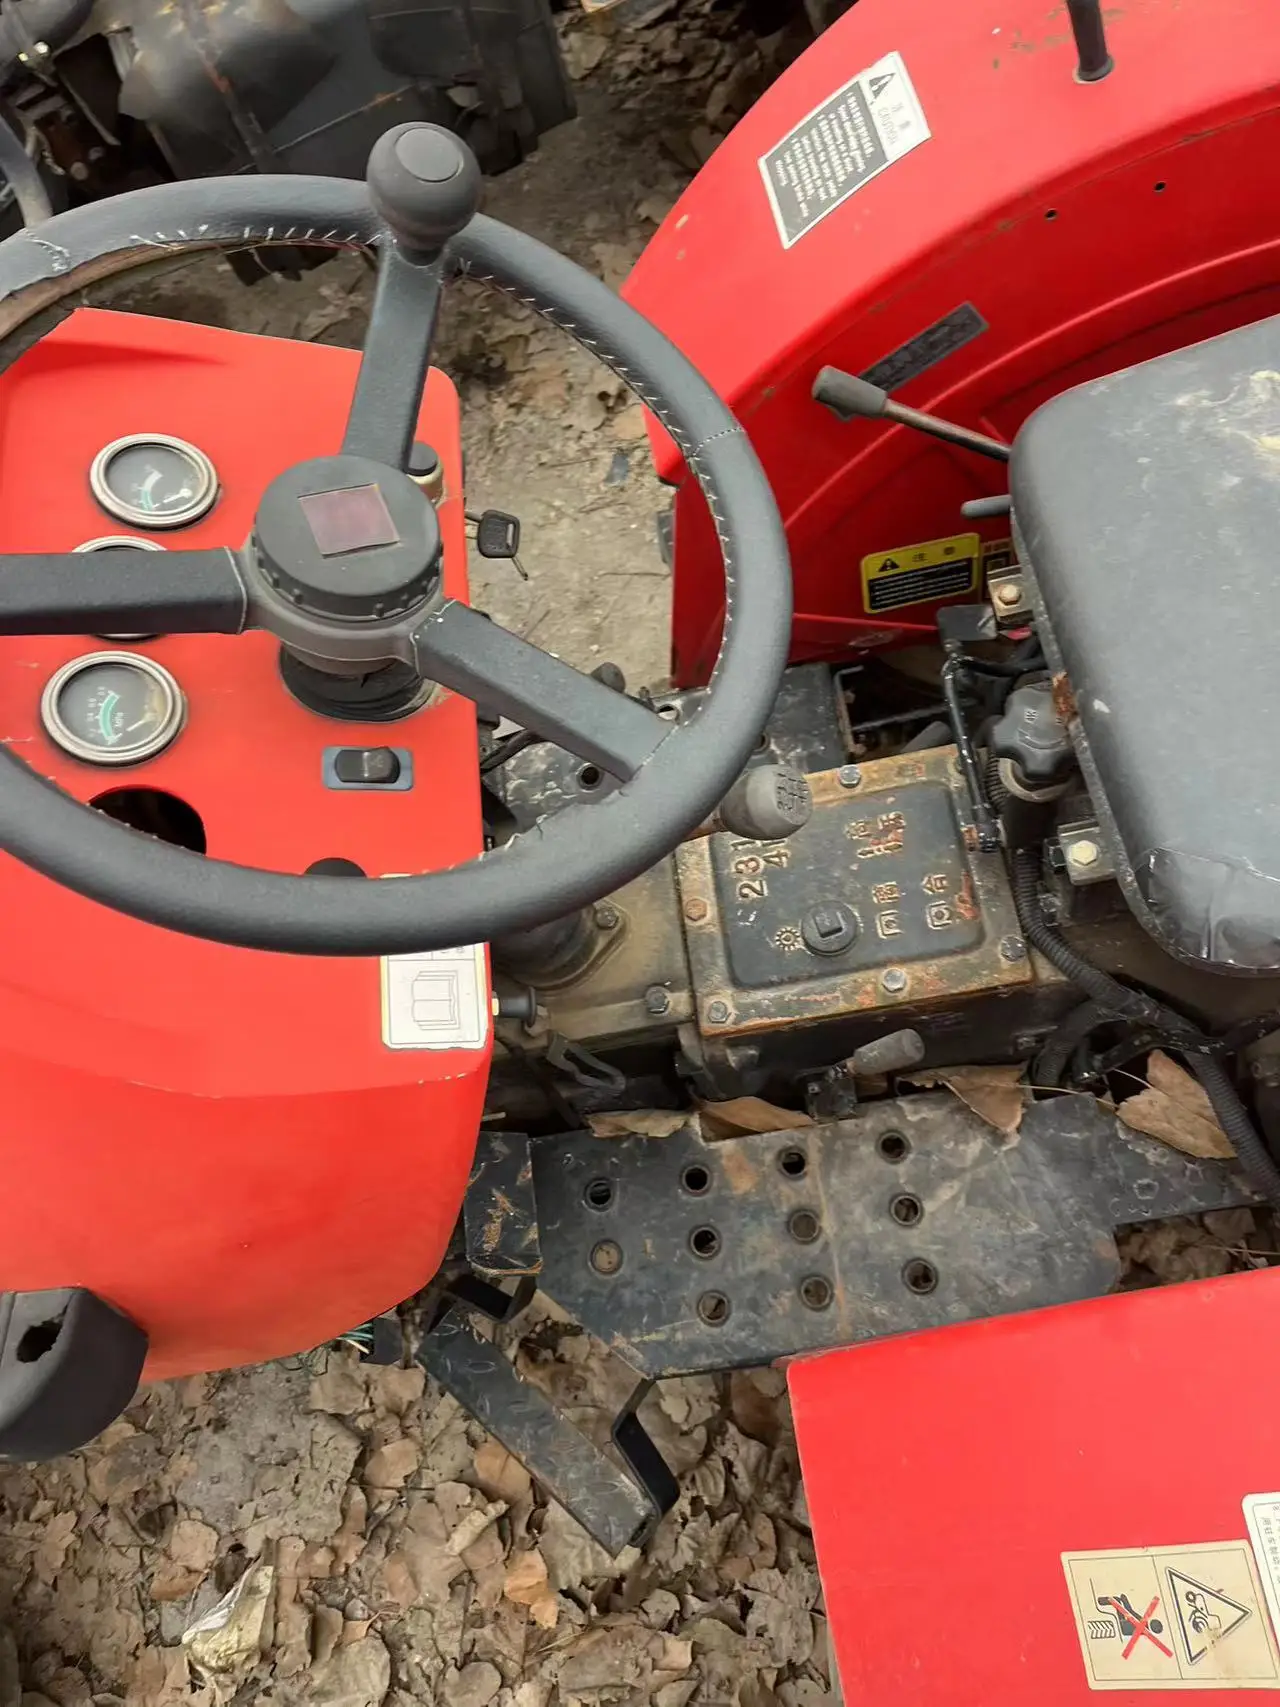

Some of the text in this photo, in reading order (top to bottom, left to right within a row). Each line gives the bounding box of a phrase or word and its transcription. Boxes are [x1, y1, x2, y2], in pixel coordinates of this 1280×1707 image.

[733, 855, 762, 874] 3
[737, 880, 768, 898] 2
[920, 873, 948, 895] 合
